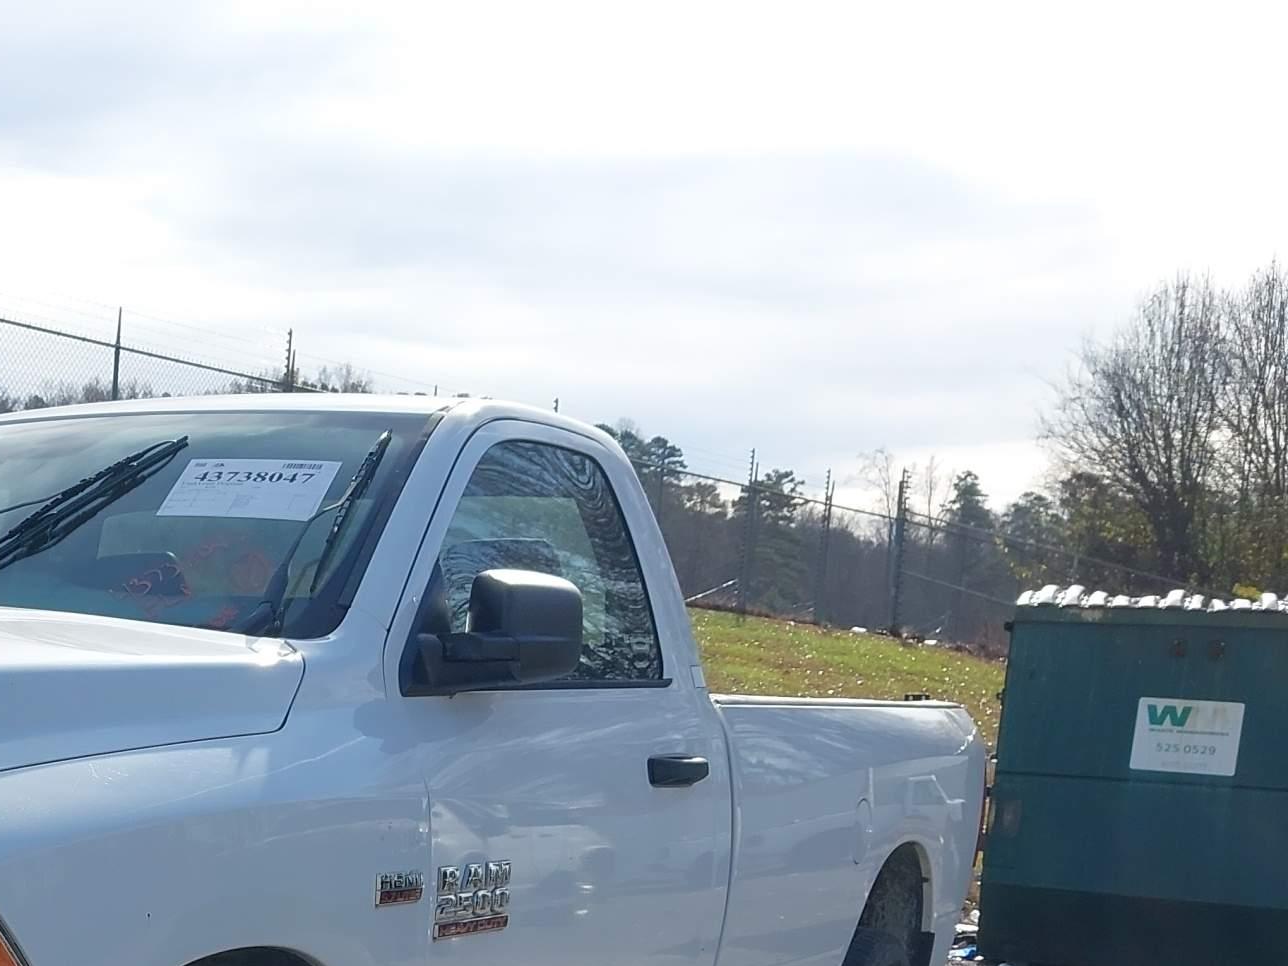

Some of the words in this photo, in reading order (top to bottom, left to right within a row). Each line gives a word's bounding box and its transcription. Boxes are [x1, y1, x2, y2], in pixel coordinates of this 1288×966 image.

[195, 471, 316, 485] 43738047
[379, 872, 424, 890] HEMI
[438, 860, 512, 894] RAM
[435, 887, 509, 919] 2500
